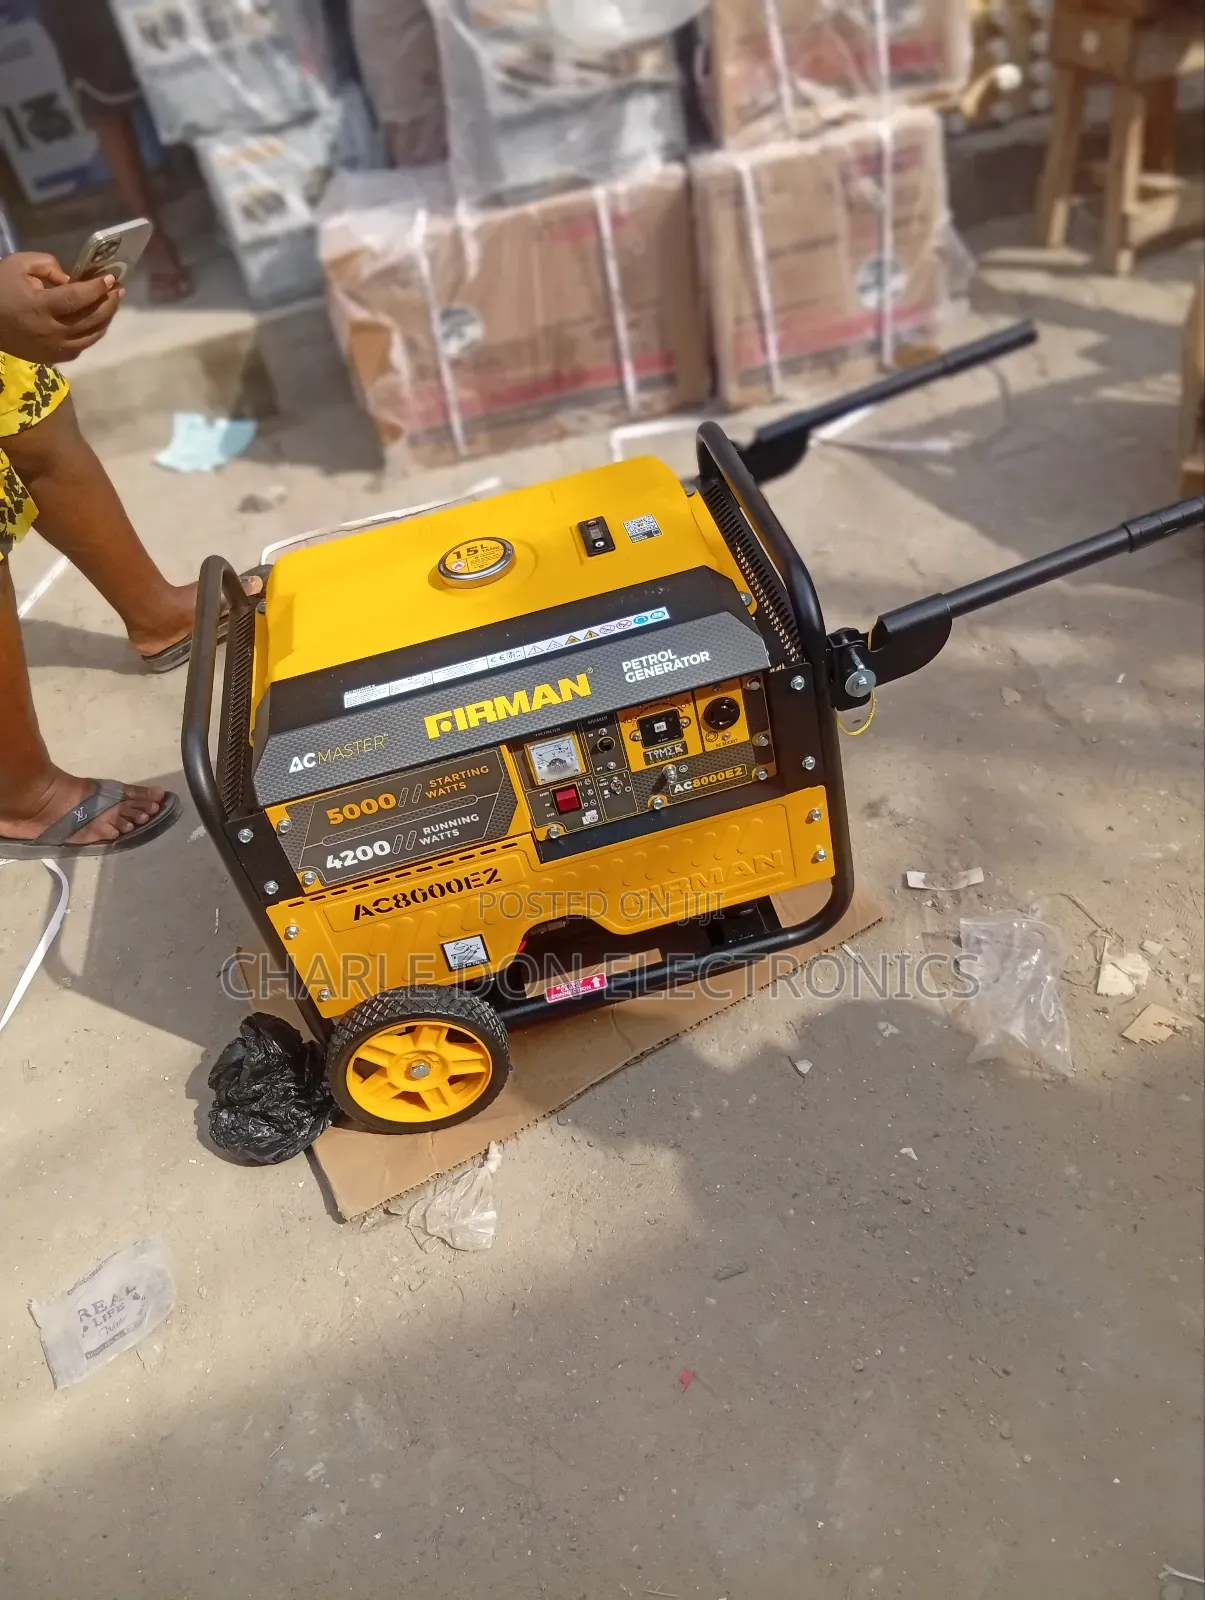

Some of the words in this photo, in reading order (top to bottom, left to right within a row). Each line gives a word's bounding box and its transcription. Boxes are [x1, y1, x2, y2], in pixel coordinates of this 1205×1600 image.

[622, 649, 677, 672] PETROL
[625, 651, 711, 683] GENERATOR
[424, 673, 592, 739] FIRMAN
[429, 765, 490, 788] STARTING
[673, 767, 744, 793] AC8000E2
[425, 781, 467, 799] WATTS
[326, 793, 397, 825] 5000
[419, 829, 460, 846] WATTS
[422, 813, 480, 836] RUNNING
[326, 840, 391, 869] 4200
[353, 867, 503, 921] AC8000E2
[92, 1302, 125, 1328] LIFE
